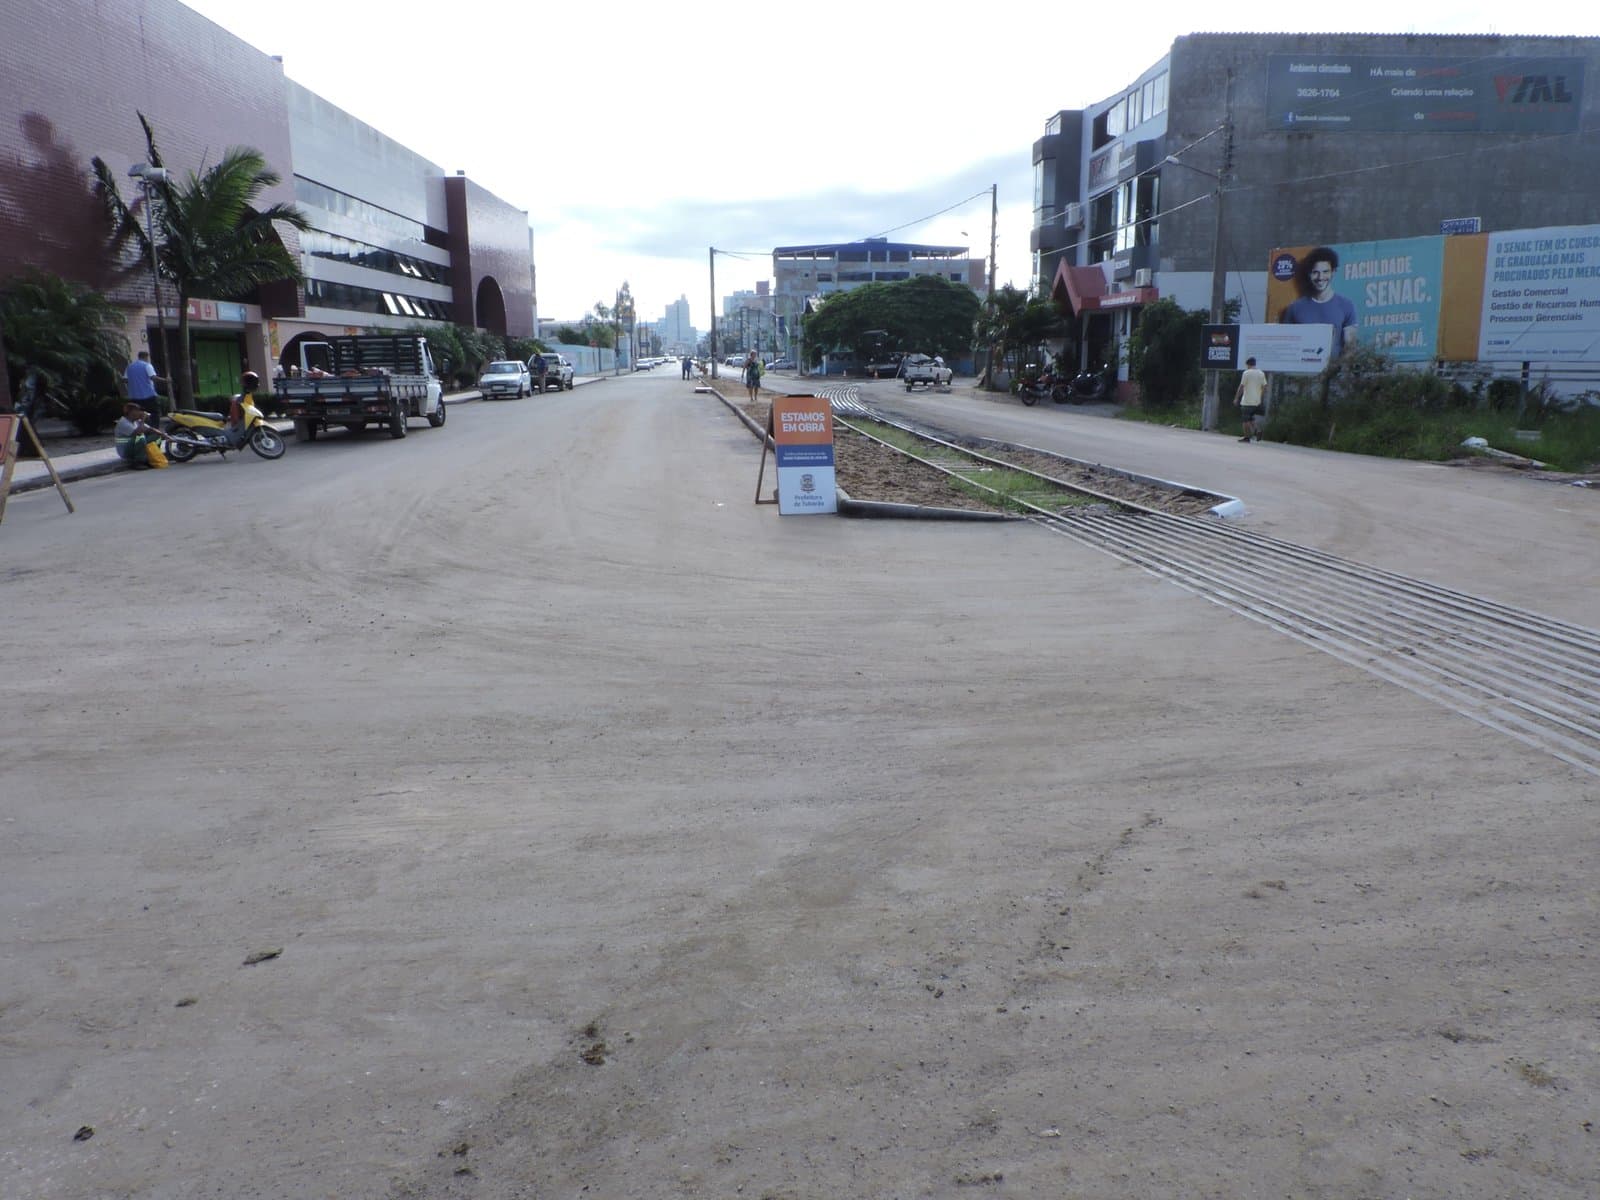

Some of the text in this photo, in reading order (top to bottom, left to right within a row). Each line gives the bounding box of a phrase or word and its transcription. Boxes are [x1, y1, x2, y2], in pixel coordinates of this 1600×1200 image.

[1370, 67, 1383, 77] HÁ
[1391, 87, 1474, 98] Criando uma relação
[1496, 236, 1600, 254] O SENAC TEM OS CURSO
[1495, 252, 1585, 268] DE GRADUAÇÃO MAIS
[1344, 255, 1413, 281] FACULDADE
[1494, 269, 1550, 282] PROCURADOS
[1551, 268, 1574, 280] PELO
[1365, 277, 1432, 308] SENAC.
[1492, 286, 1569, 298] Gestão Comercial
[1491, 301, 1520, 311] Gestão
[1522, 300, 1533, 310] de
[1535, 299, 1577, 309] Recursos
[1489, 312, 1583, 323] Processos Gerenciais
[781, 412, 825, 422] ESTAMOS
[783, 422, 825, 432] EM OBRA
